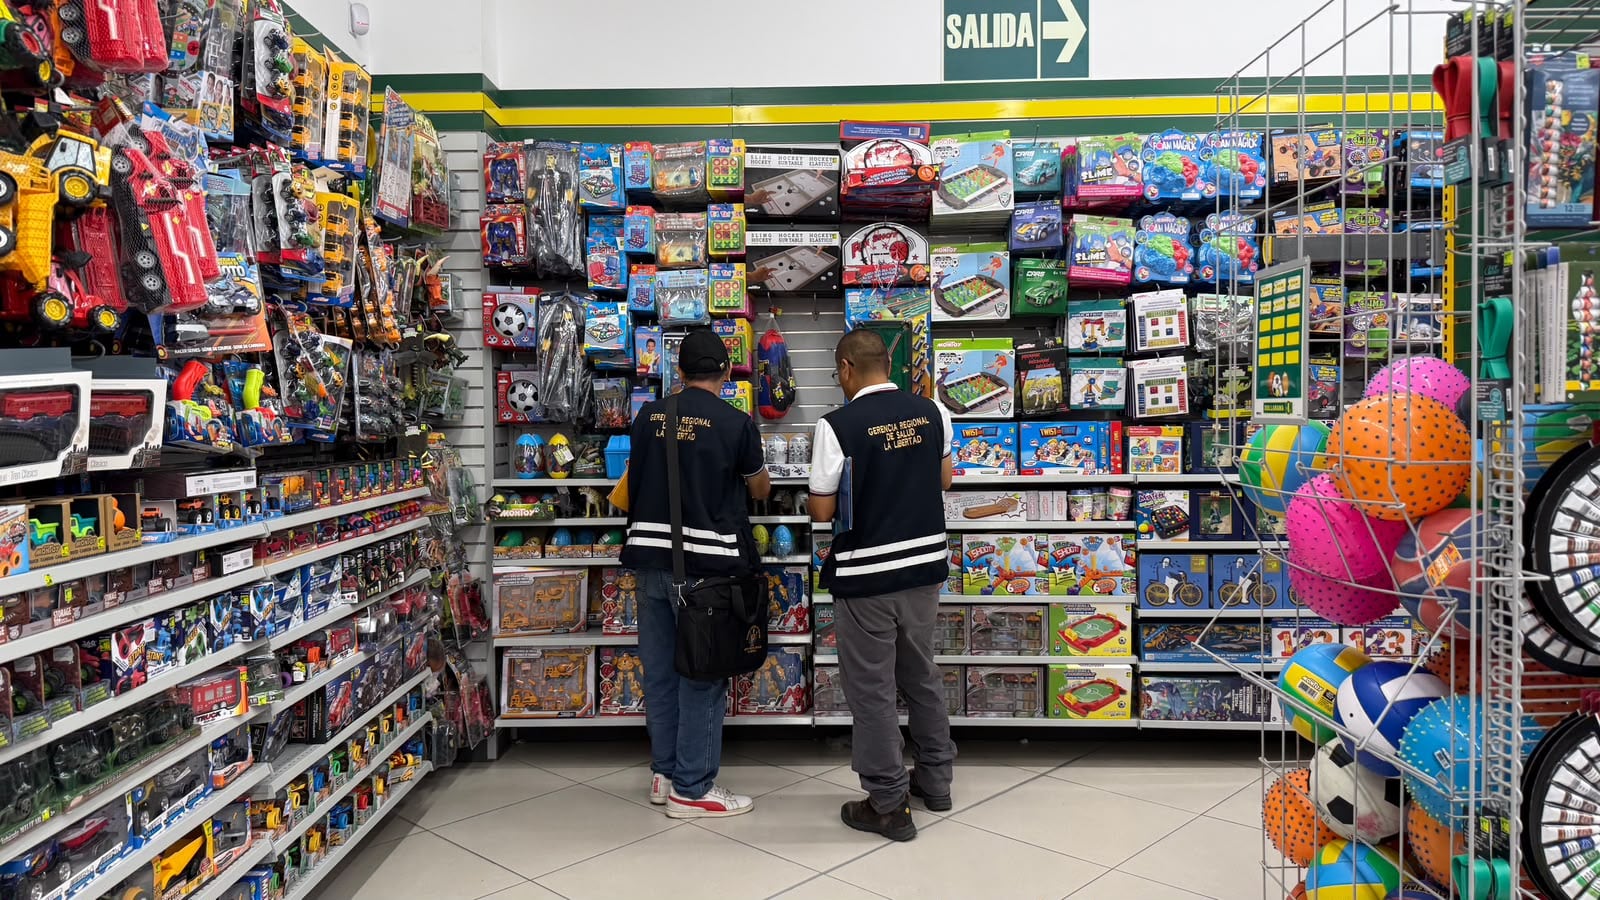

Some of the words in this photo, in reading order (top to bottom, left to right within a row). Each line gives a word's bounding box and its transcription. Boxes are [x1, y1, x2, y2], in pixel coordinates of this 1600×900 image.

[947, 13, 1034, 49] SALIDA
[1081, 166, 1114, 181] SLIME
[1074, 250, 1107, 262] SLIME
[681, 416, 711, 428] REGIONAL
[867, 420, 898, 436] GERENCIA
[899, 415, 930, 430] REGIONAL
[655, 428, 665, 438] LA
[886, 432, 894, 441] DE
[896, 428, 916, 440] SALUD
[962, 429, 979, 438] TWIST
[1040, 428, 1058, 437] TWIST
[883, 443, 892, 451] LA
[893, 434, 923, 449] LIBERTAD
[499, 508, 535, 518] MONTOY
[53, 606, 73, 620] STORAGE
[128, 640, 148, 668] STUNT
[195, 710, 222, 723] TRUCK
